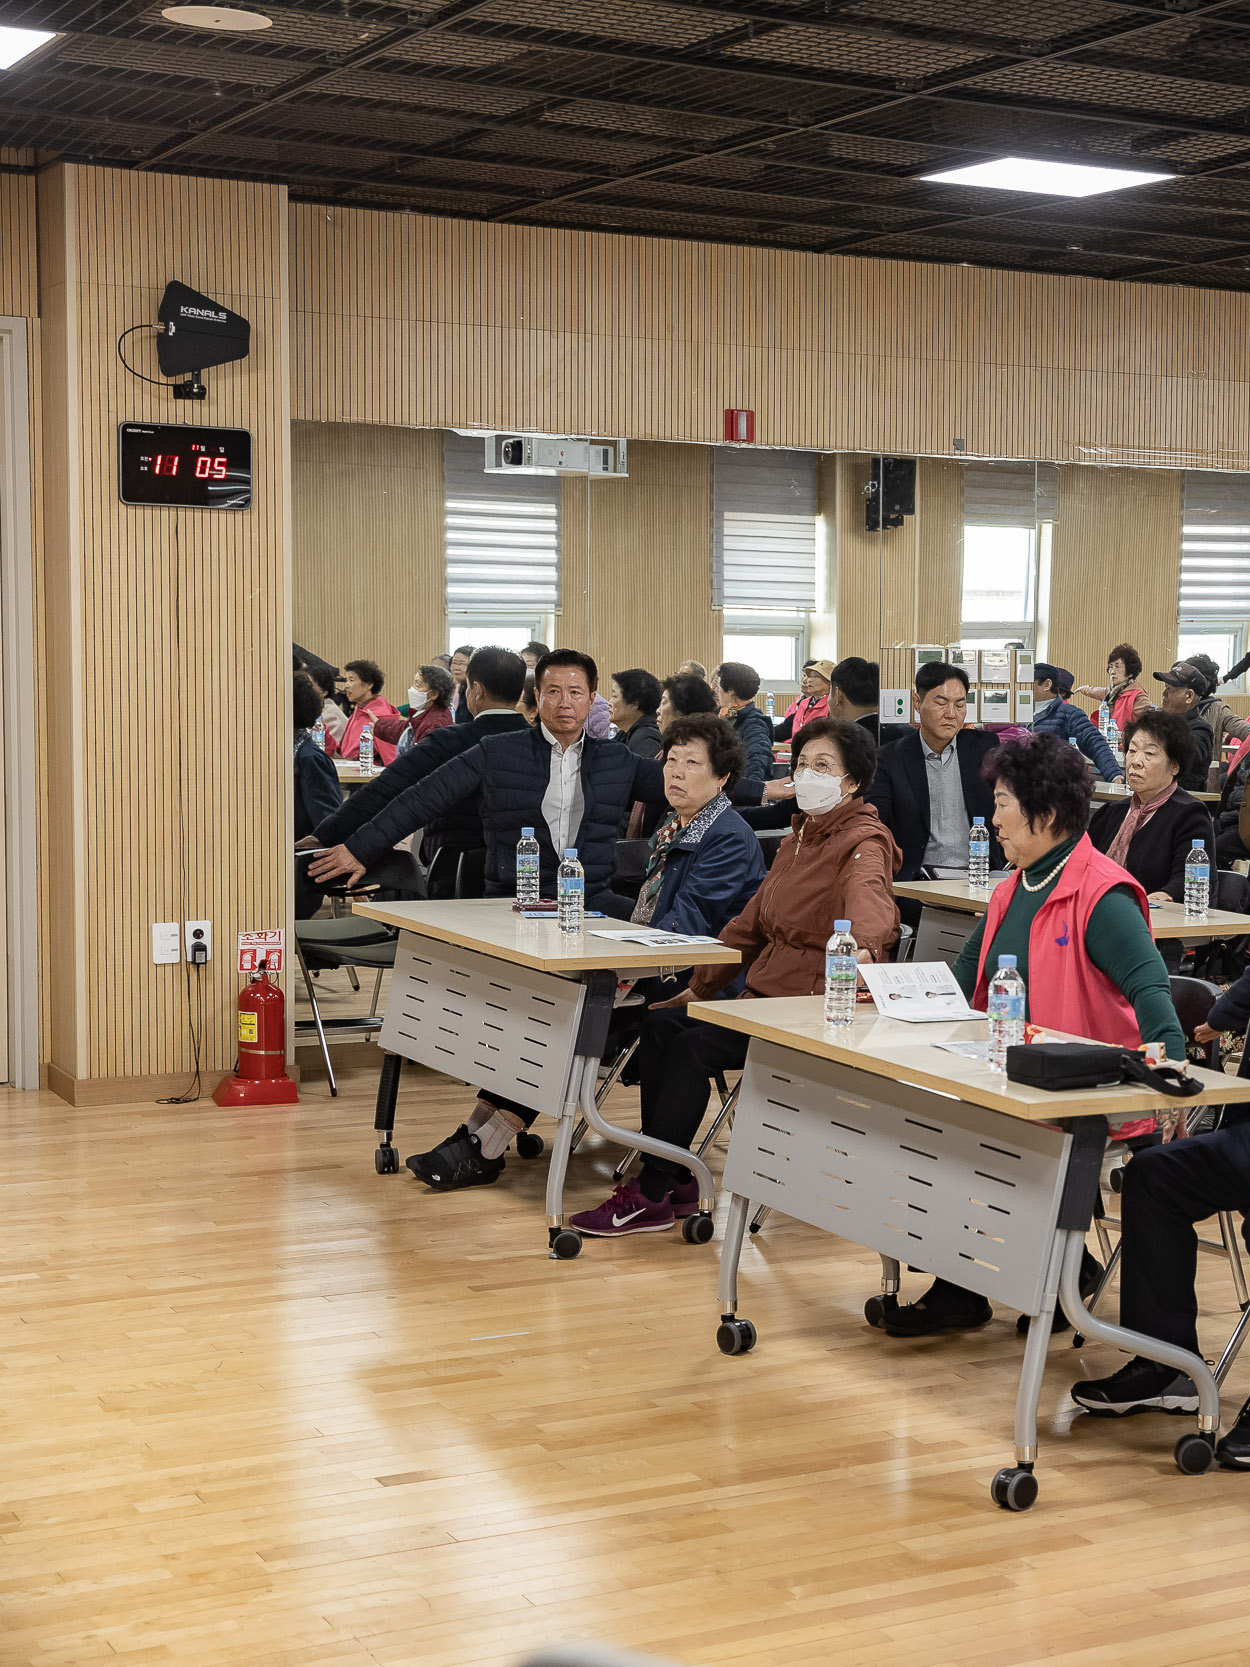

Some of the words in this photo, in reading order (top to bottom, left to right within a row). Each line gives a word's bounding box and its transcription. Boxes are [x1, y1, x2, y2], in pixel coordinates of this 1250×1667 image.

[180, 305, 227, 319] KANALS
[154, 454, 179, 476] 11
[195, 456, 228, 479] 05
[241, 930, 281, 941] 소화기
